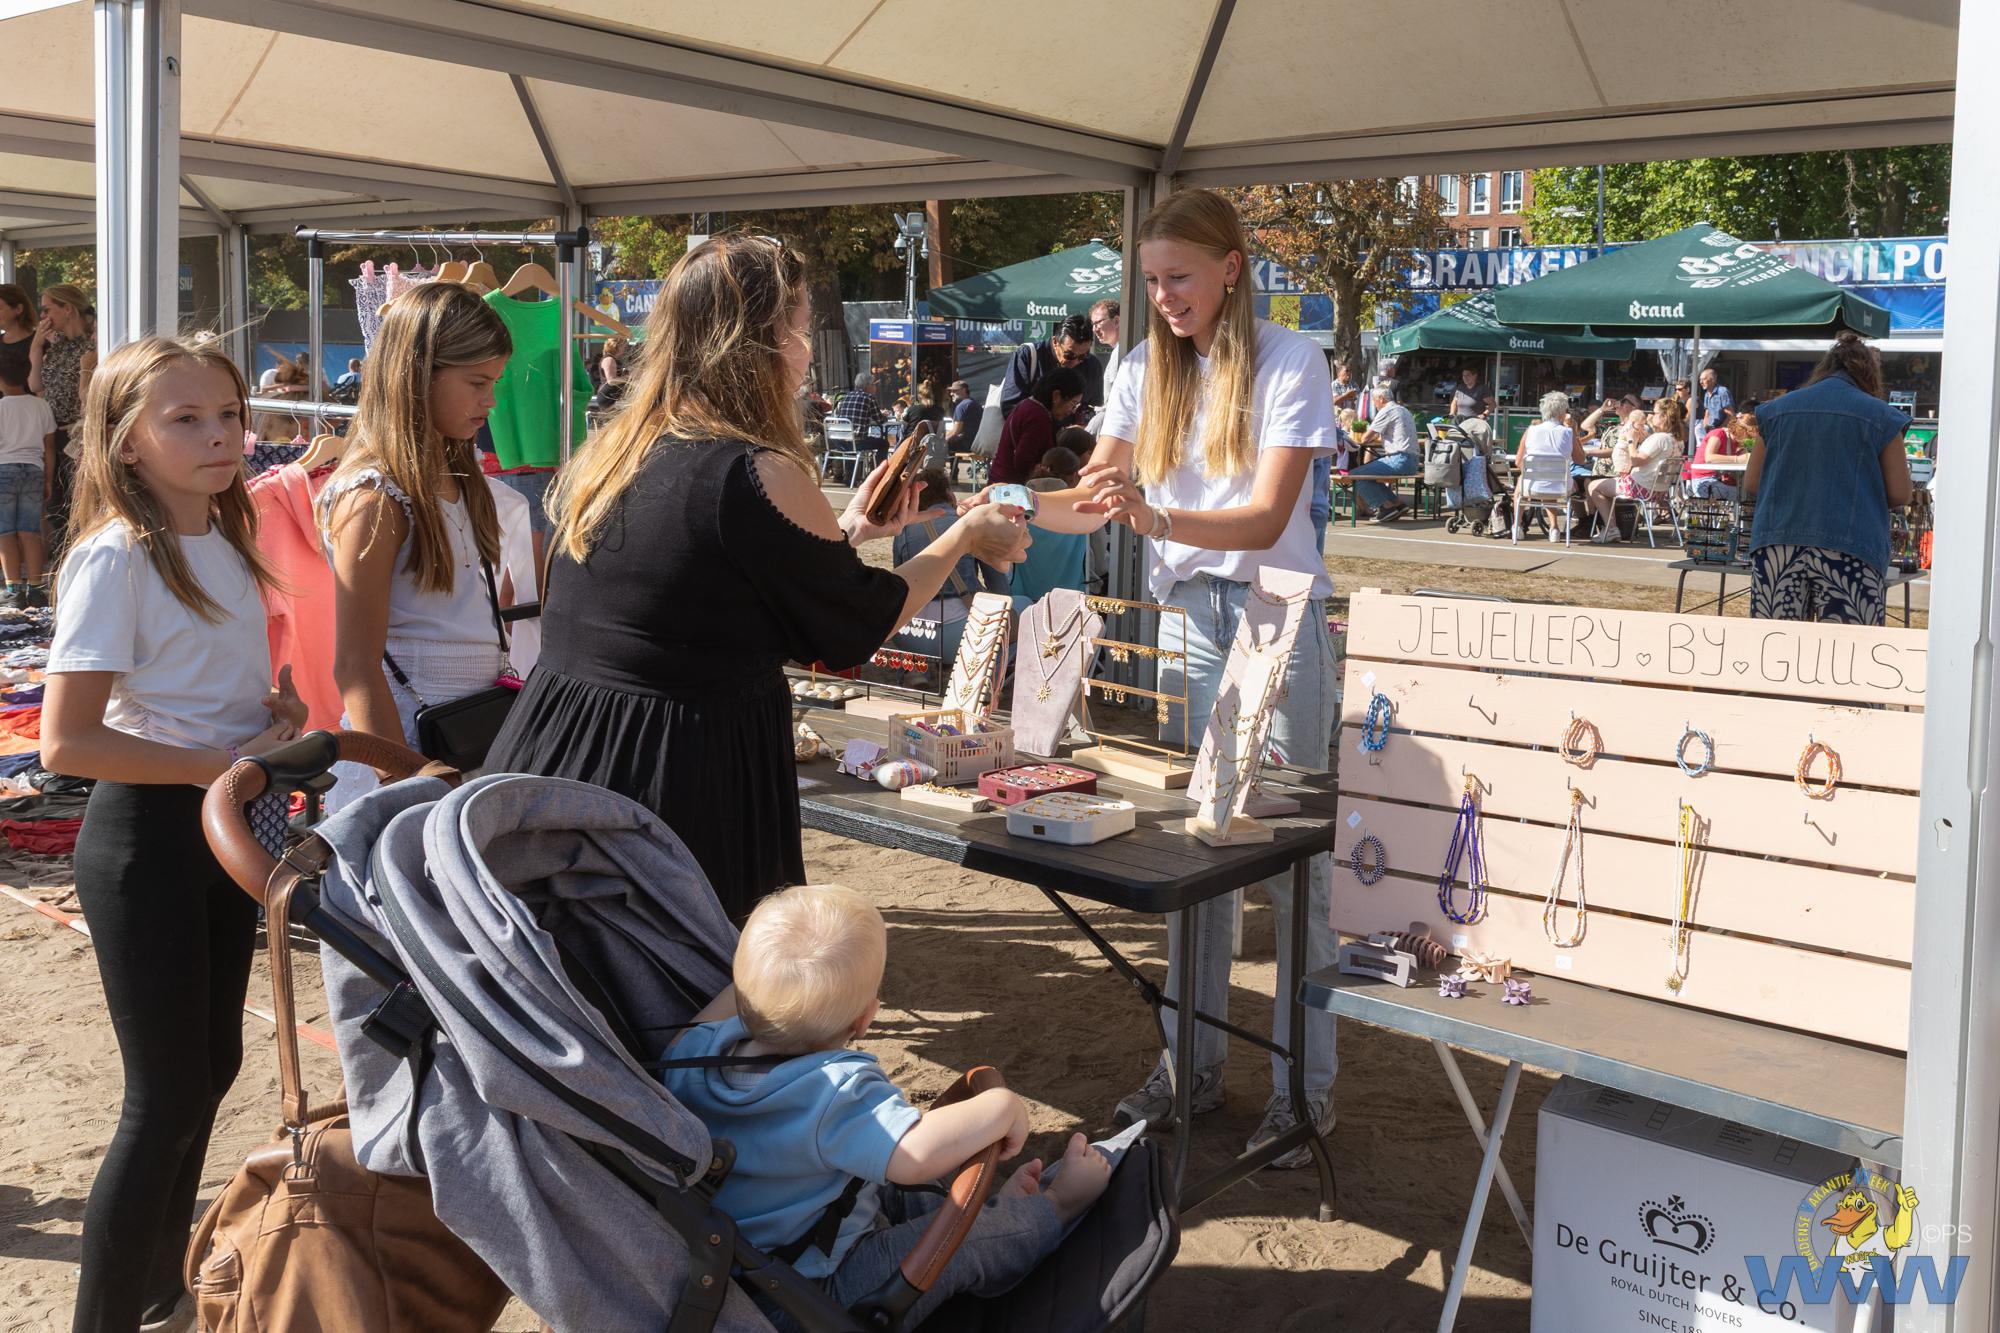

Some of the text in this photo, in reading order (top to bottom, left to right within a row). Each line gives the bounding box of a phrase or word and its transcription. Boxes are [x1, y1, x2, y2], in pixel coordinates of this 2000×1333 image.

[1027, 301, 1067, 316] Brand
[1629, 300, 1685, 319] Brand
[1509, 336, 1545, 350] Brand
[1398, 605, 1622, 668] JEWELLERY
[1668, 623, 1726, 676] BY
[1557, 1223, 1589, 1255] De
[1599, 1239, 1711, 1293] Gruijter
[1721, 1274, 1746, 1306] &
[1611, 1276, 1743, 1328] ROYAL DUTCH MOVERS
[1638, 1309, 1678, 1333] SINCE
